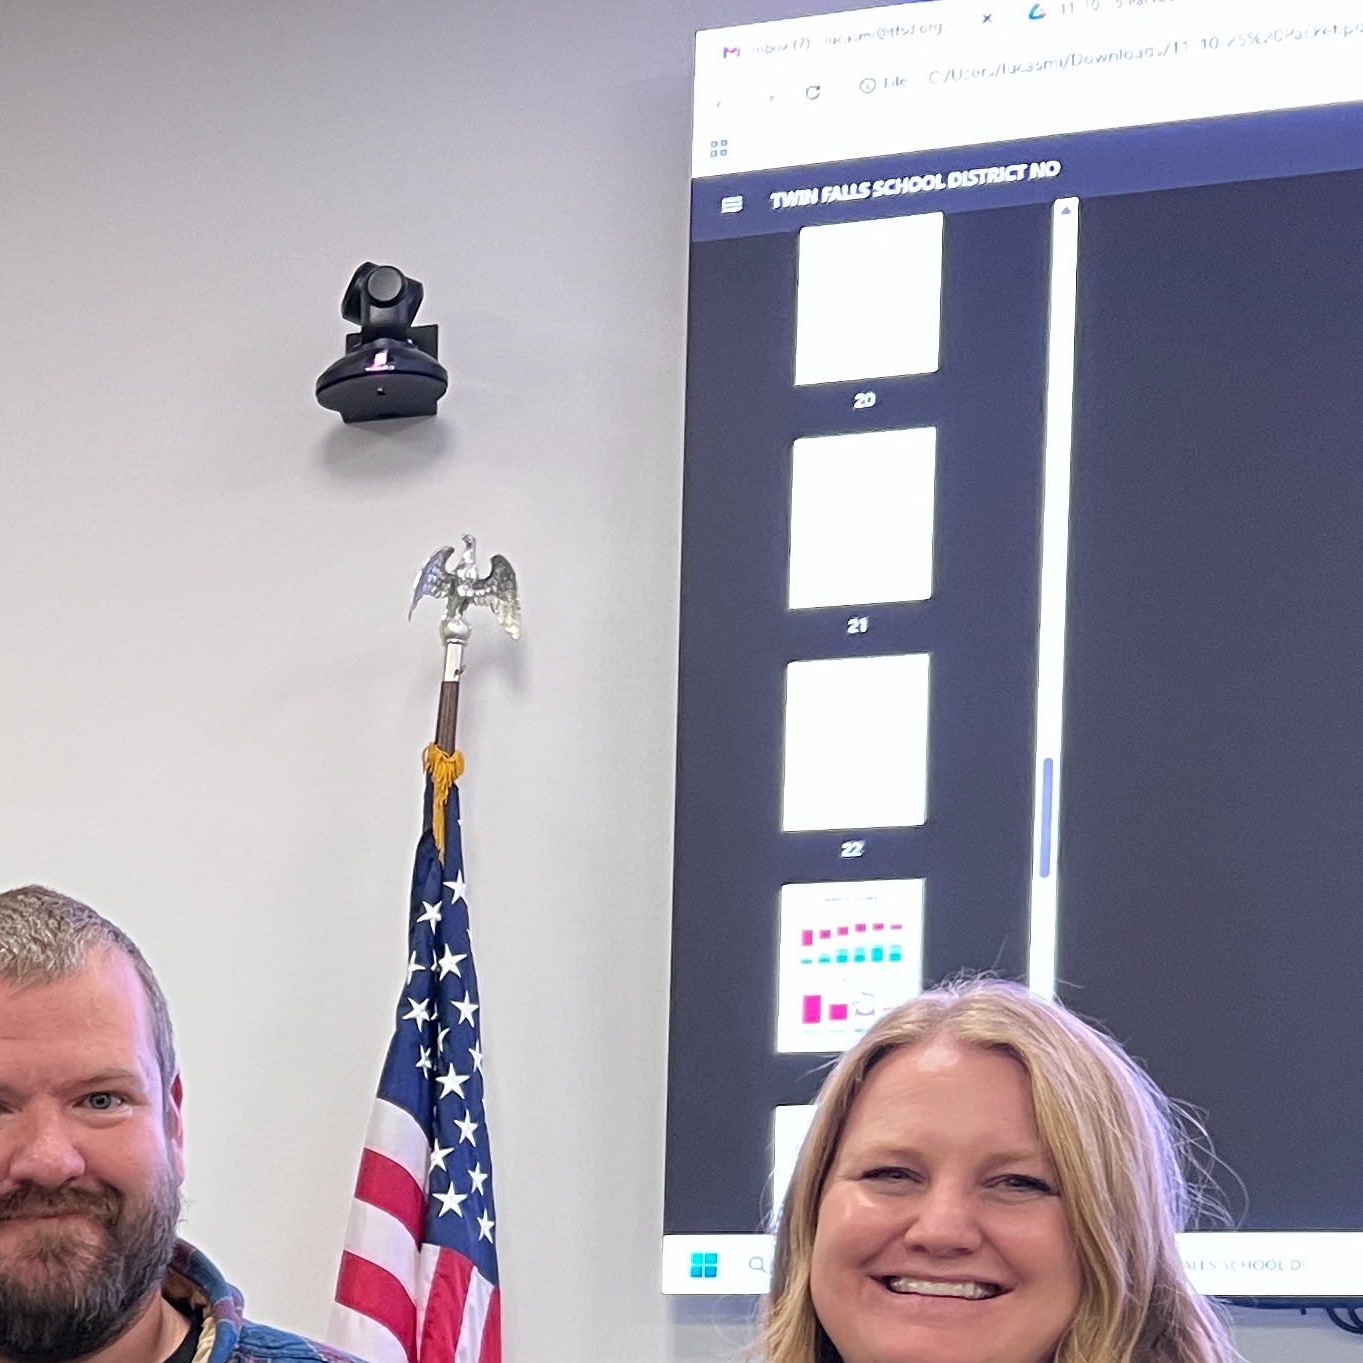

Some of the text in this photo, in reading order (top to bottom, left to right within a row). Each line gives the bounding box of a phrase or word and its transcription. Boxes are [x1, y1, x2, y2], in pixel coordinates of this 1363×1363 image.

[770, 160, 1062, 209] TWIN FALLS SCHOOL DISTRICT NO
[853, 392, 876, 409] 20
[847, 617, 868, 634] 21
[841, 841, 865, 858] 22
[1184, 1259, 1217, 1271] ALLS
[1223, 1259, 1284, 1271] SCHOOL
